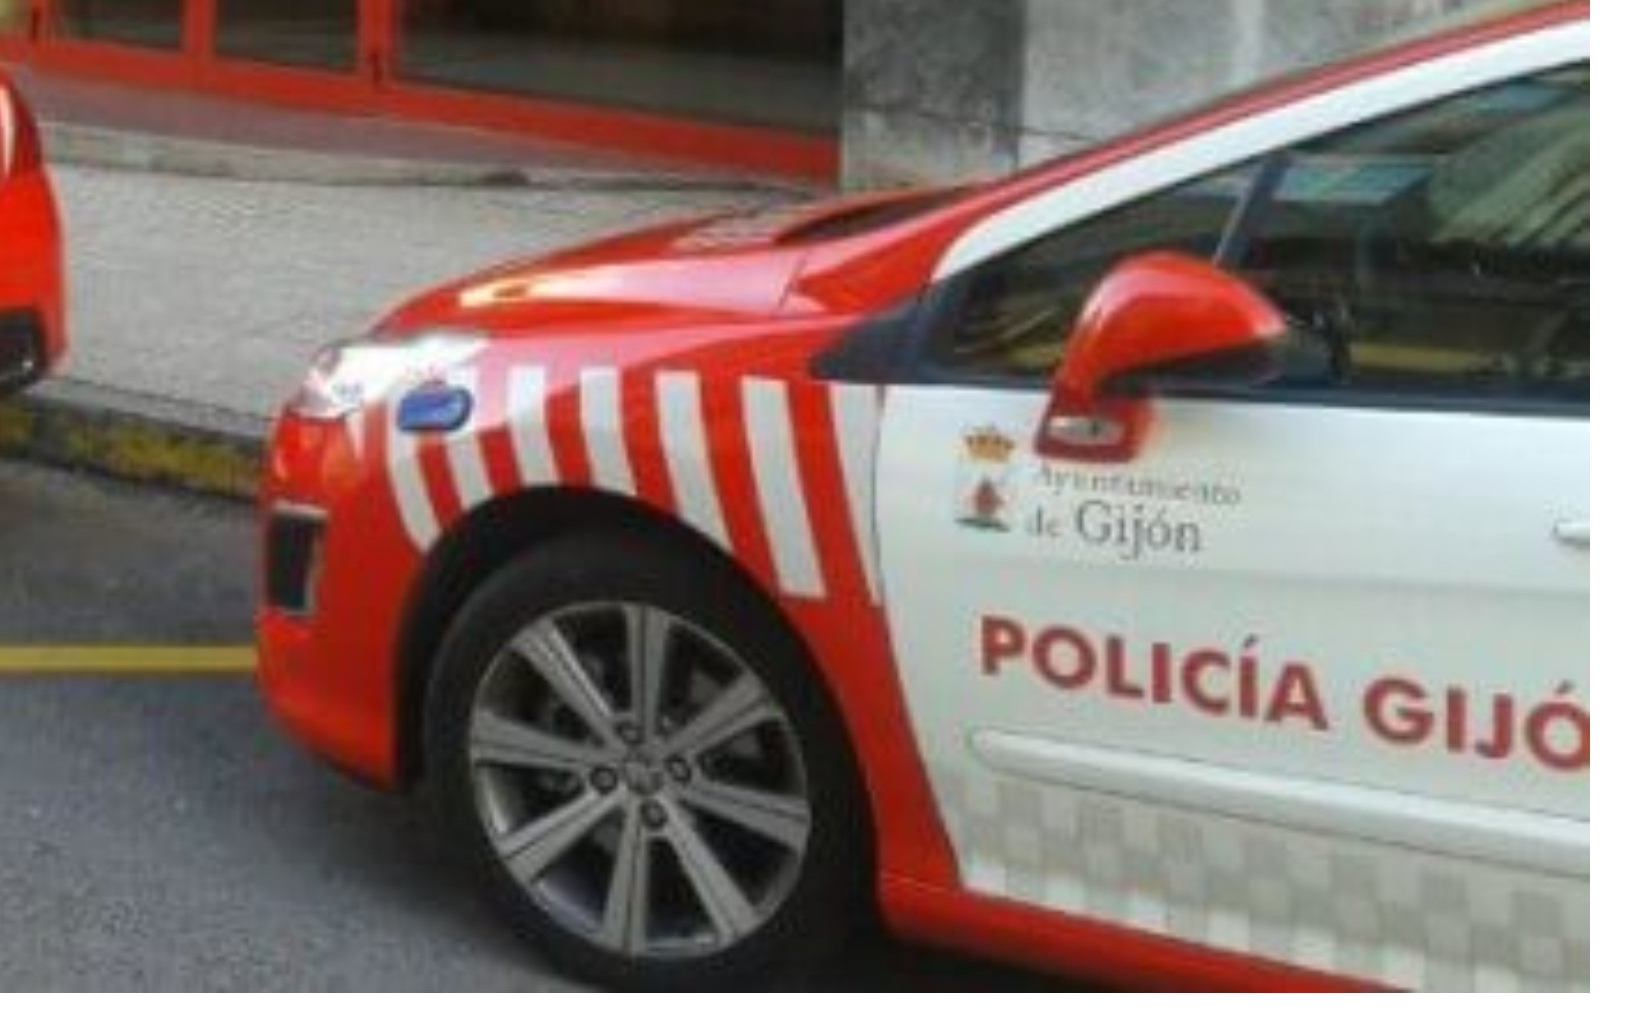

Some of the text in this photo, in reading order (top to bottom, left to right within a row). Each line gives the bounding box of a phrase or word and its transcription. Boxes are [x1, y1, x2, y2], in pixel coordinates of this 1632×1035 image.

[1028, 498, 1202, 560] de Gijón
[980, 615, 1330, 731] POLICÍA
